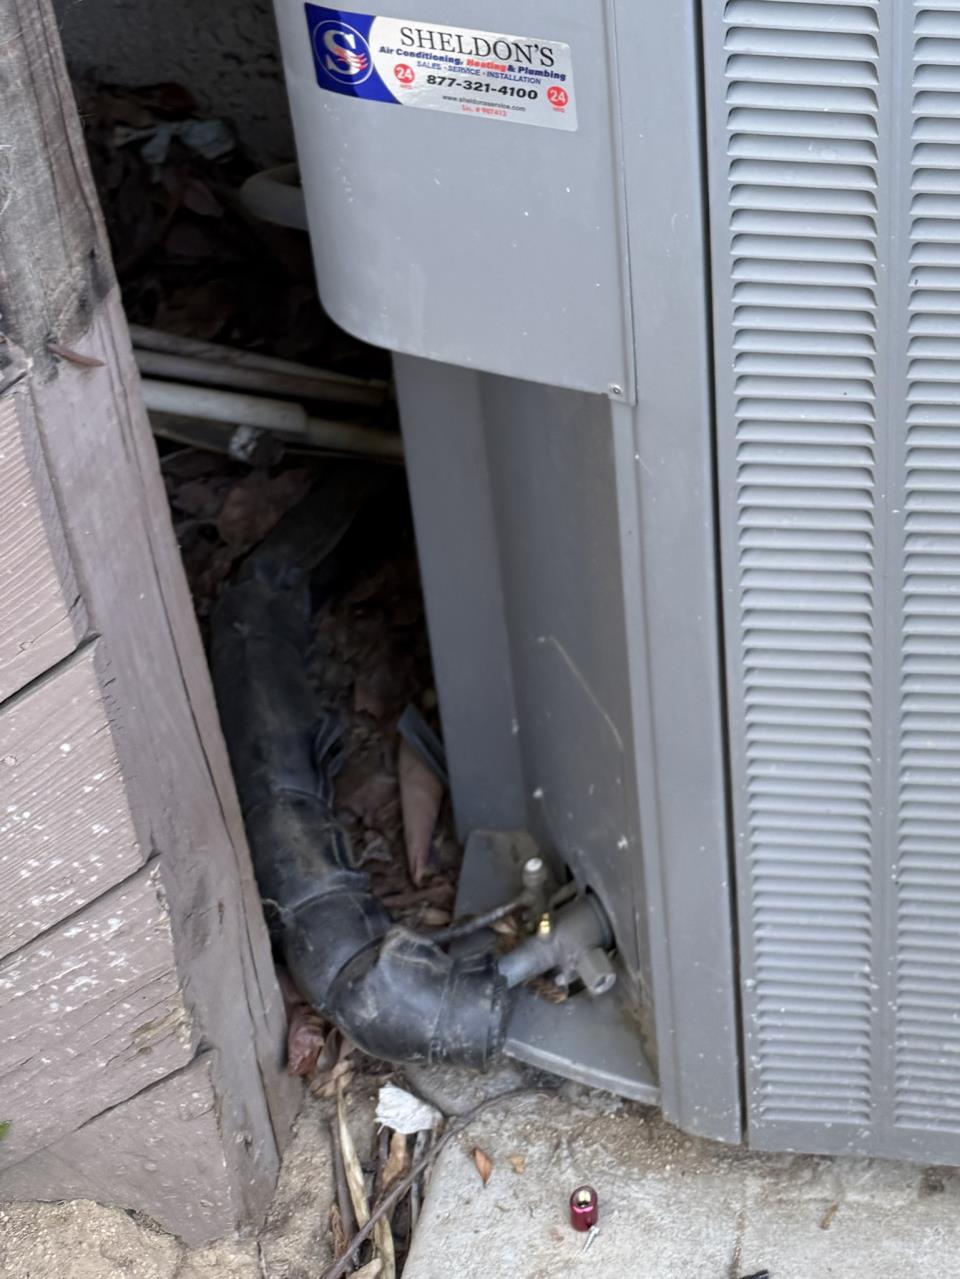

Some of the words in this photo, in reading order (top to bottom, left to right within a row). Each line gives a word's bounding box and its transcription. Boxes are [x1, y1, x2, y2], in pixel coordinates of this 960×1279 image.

[400, 26, 555, 67] SHELDON'S
[378, 46, 394, 55] Air
[396, 48, 464, 65] Conditioning,
[466, 59, 507, 73] Heating
[507, 64, 516, 73] &
[518, 66, 567, 81] Plumbing
[396, 66, 413, 80] 24
[416, 61, 442, 70] SALES
[448, 65, 481, 76] SERVICE
[487, 71, 542, 85] INSTALLATION
[426, 74, 539, 100] 877-321-4100
[549, 90, 567, 103] 24
